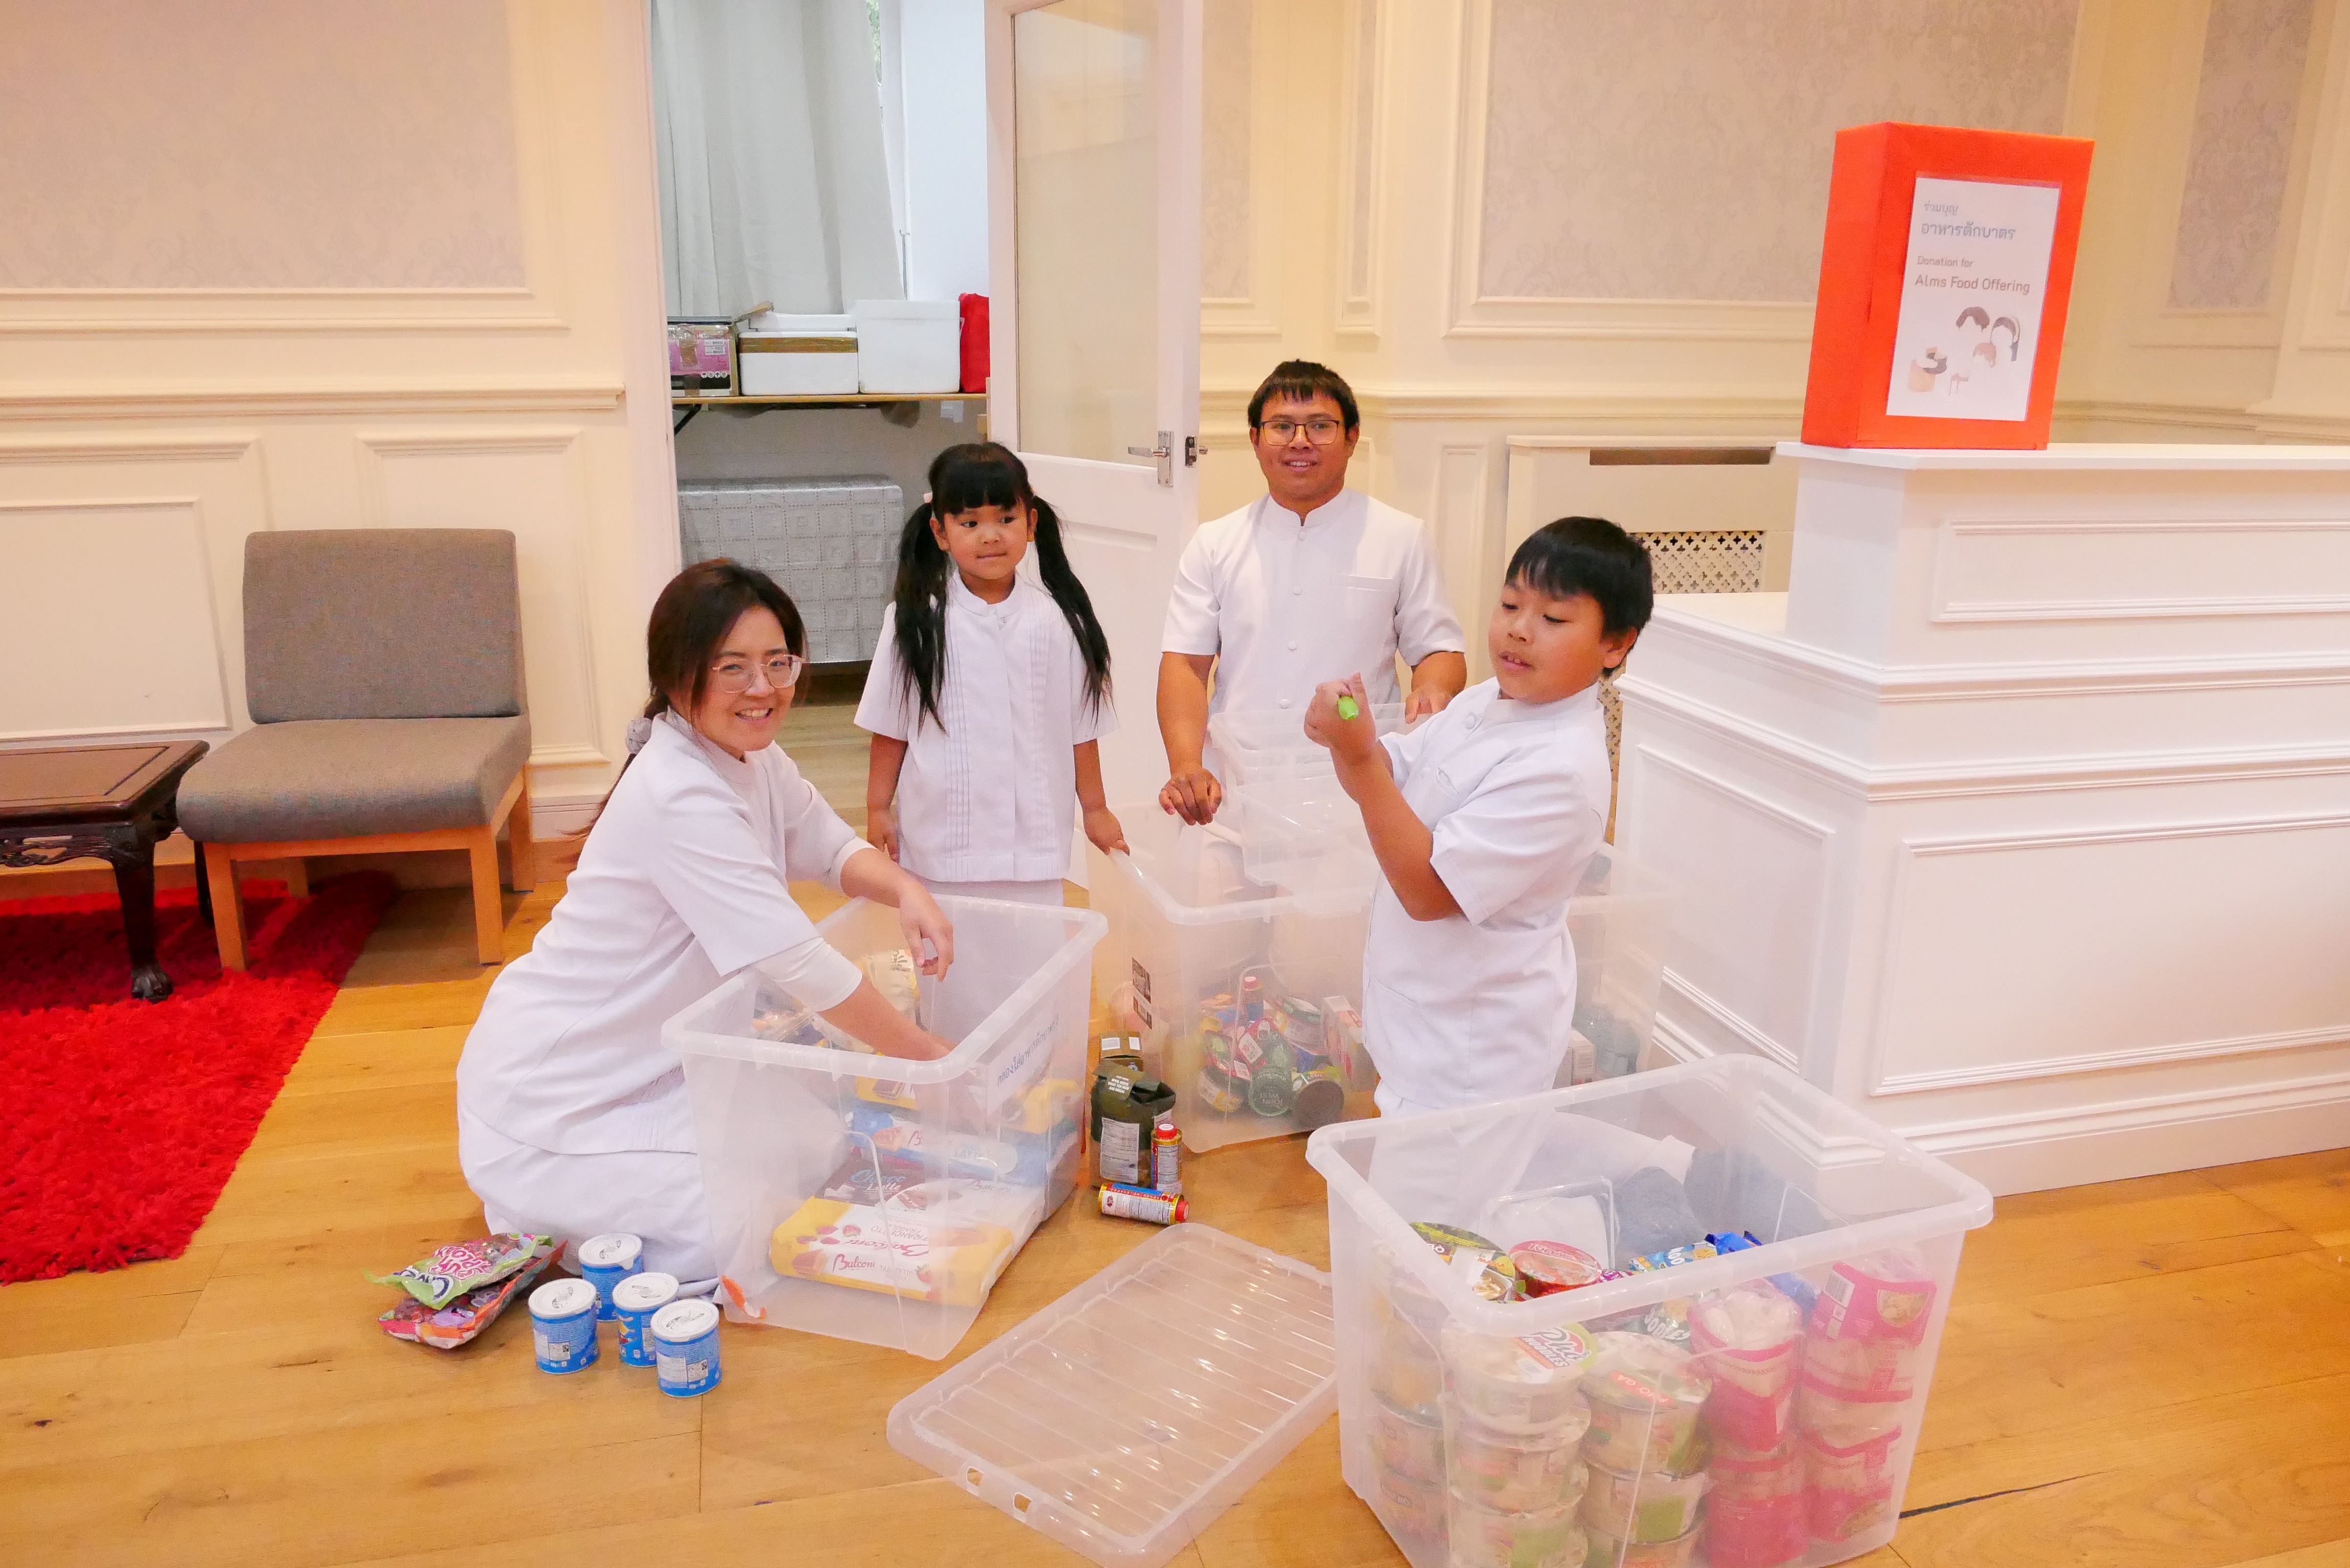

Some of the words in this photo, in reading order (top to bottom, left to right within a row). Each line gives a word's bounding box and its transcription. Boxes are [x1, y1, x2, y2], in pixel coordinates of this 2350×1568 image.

[1924, 200, 1959, 216] ร่วมบุญ
[1921, 221, 2016, 240] อาหารตักบาตร
[1917, 255, 1958, 268] Donation
[1961, 257, 1974, 268] for
[1915, 274, 1947, 288] Alms
[1950, 276, 1979, 290] Food
[1982, 277, 2031, 295] Offering
